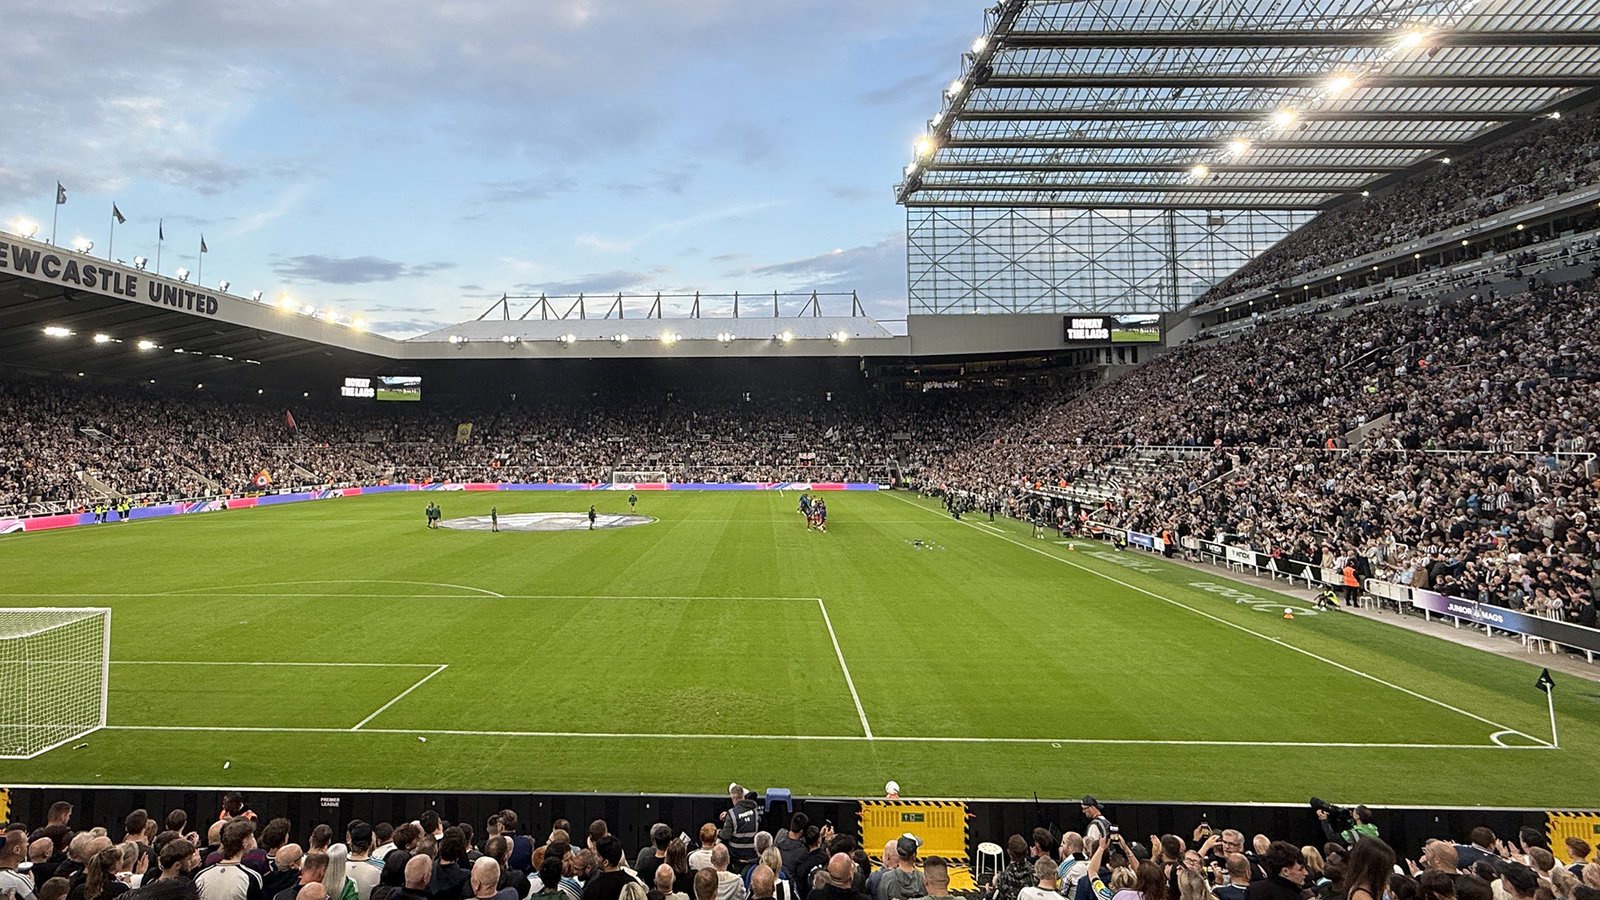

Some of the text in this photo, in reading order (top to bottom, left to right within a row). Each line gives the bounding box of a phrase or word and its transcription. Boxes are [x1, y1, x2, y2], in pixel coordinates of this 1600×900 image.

[149, 281, 218, 314] UNITED
[1067, 328, 1109, 339] THE LADS
[340, 386, 375, 397] THE LADS
[1447, 603, 1504, 623] JUNIOR MAGS
